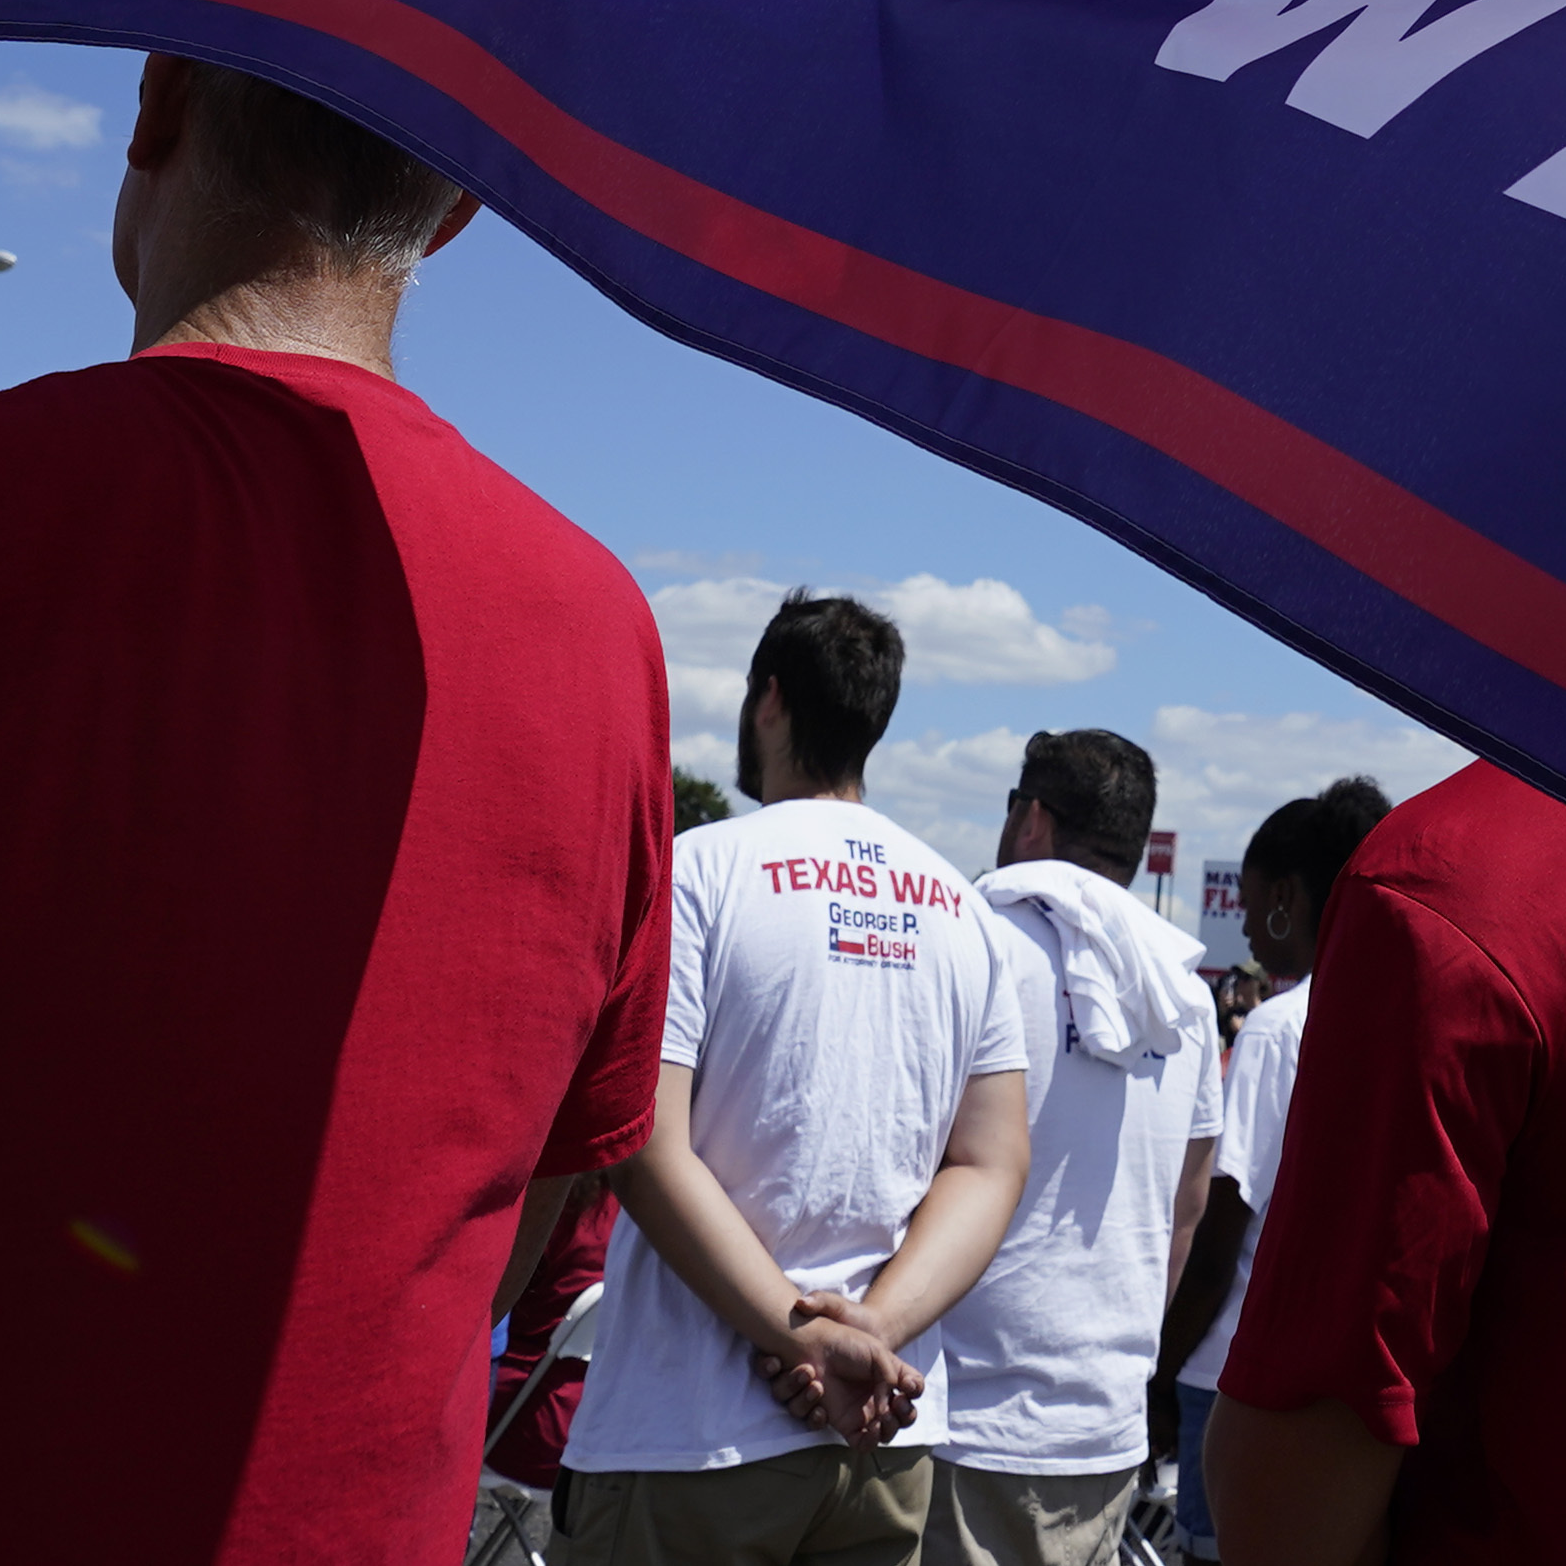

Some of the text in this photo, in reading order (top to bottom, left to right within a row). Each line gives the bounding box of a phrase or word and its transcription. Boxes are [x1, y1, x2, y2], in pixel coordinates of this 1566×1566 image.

[845, 839, 887, 864] THE
[761, 857, 961, 918] TEXAS WAY
[902, 912, 920, 935] P.
